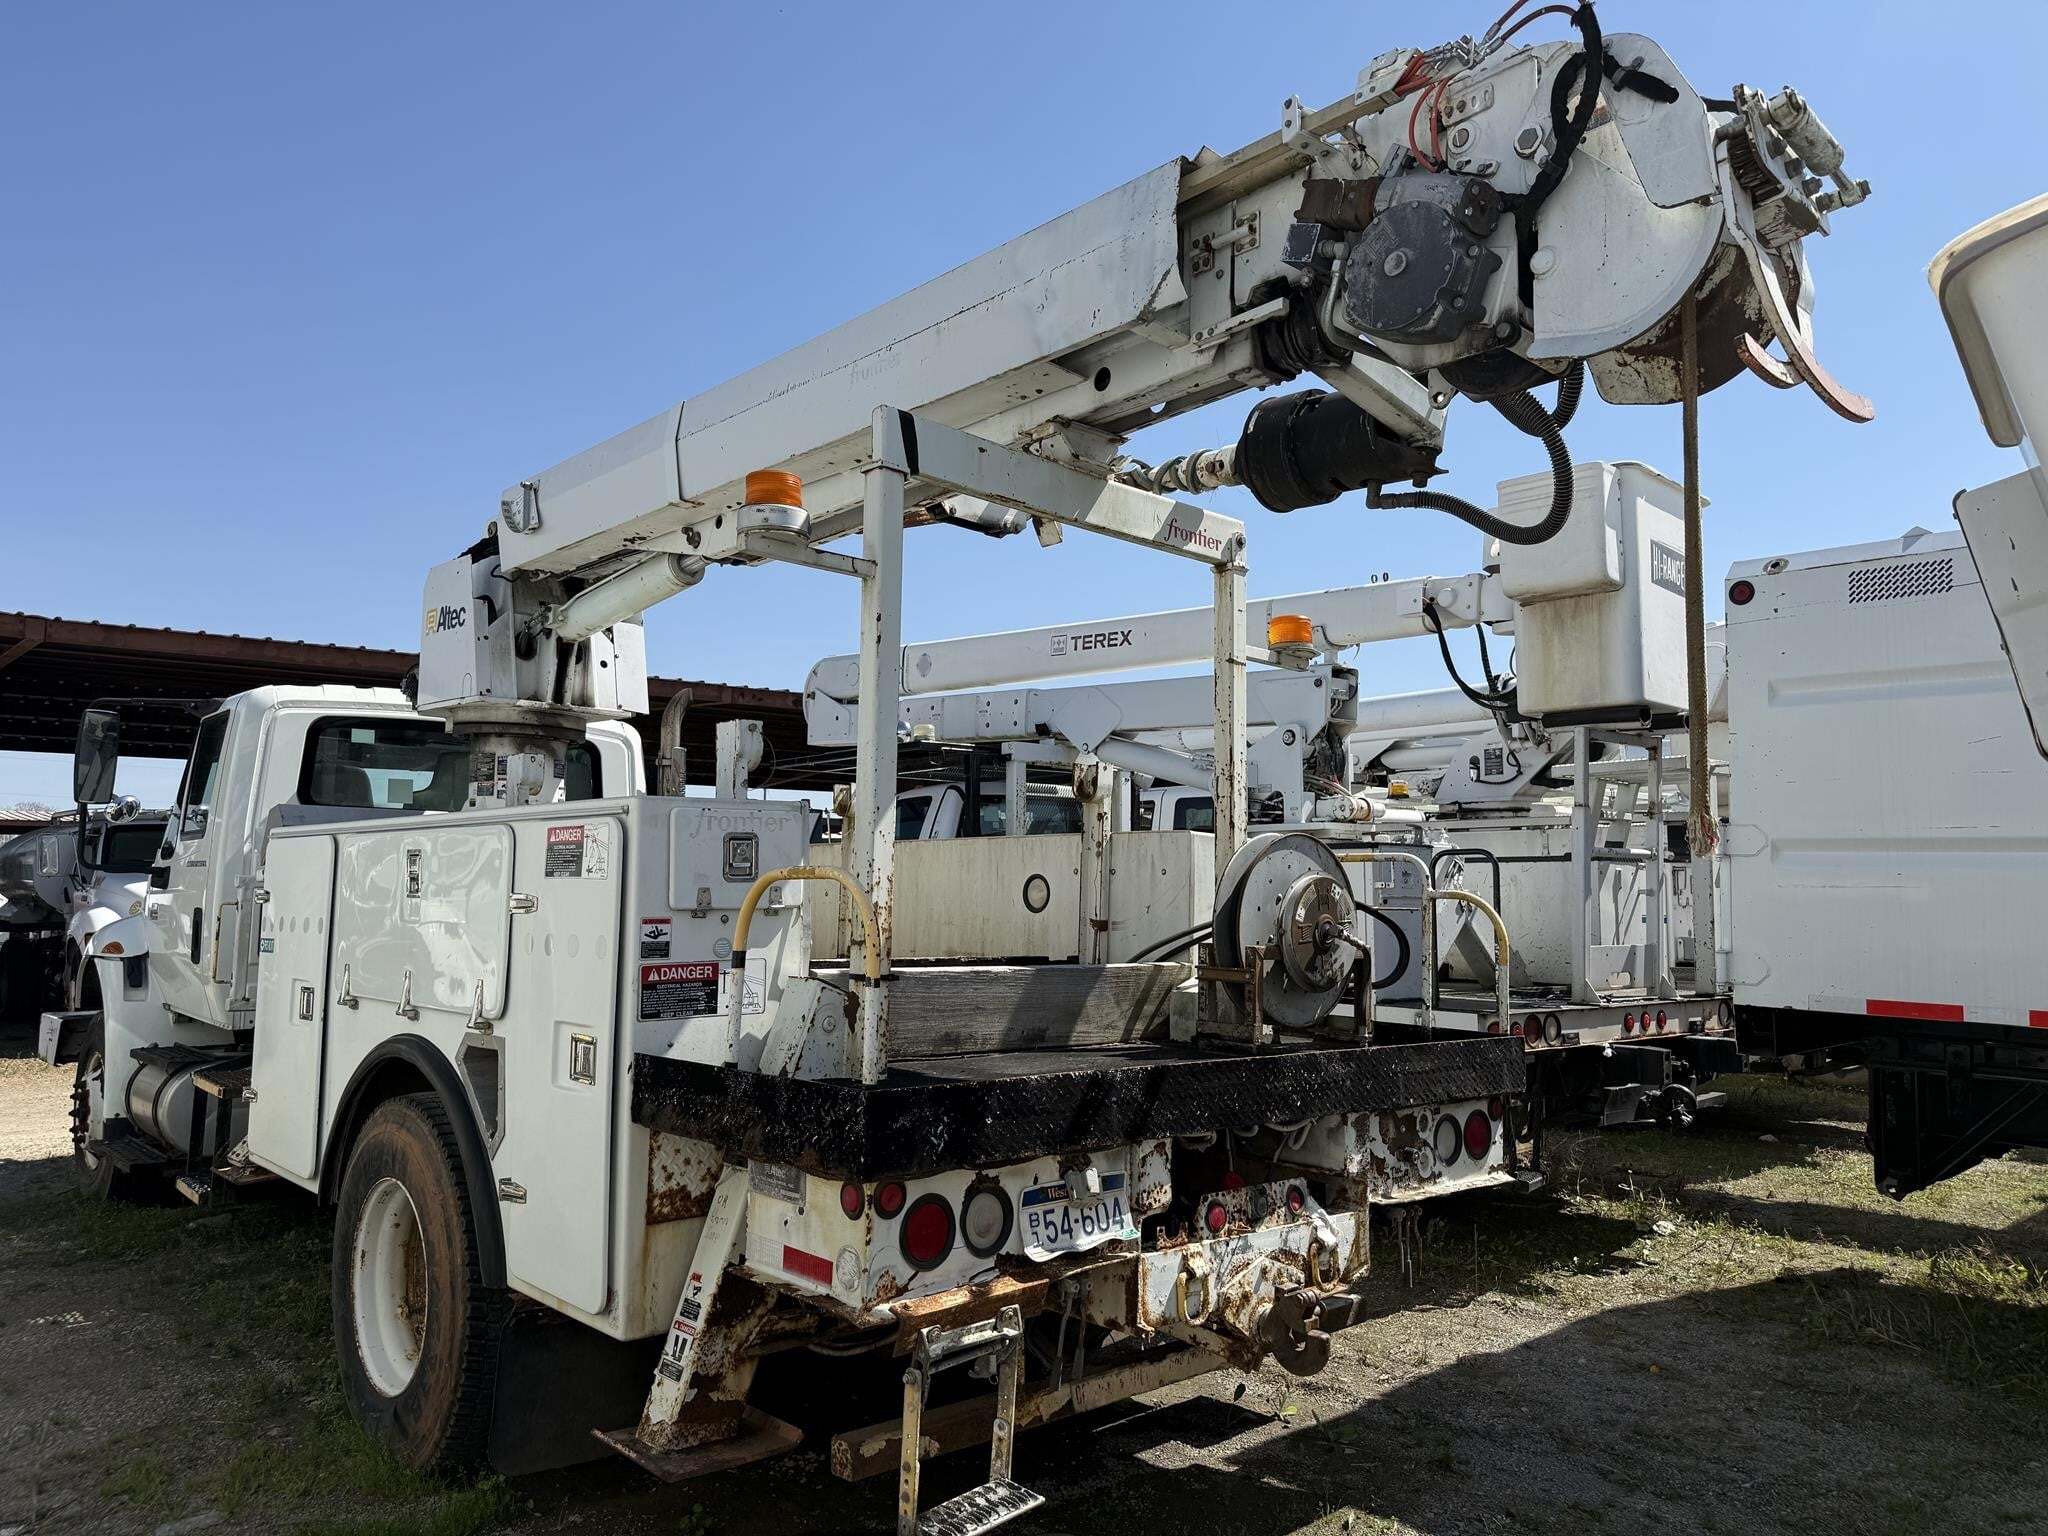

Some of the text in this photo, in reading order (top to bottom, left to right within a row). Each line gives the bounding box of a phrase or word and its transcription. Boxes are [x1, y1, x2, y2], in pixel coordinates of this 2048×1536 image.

[1164, 518, 1222, 551] frontier
[1653, 543, 1686, 592] HI-RANGE
[436, 605, 467, 632] Altec
[1070, 629, 1133, 652] TEREX
[555, 828, 582, 841] DANGER
[660, 965, 713, 981] DANGER
[1047, 1186, 1069, 1200] West
[1042, 1196, 1126, 1244] 54-604
